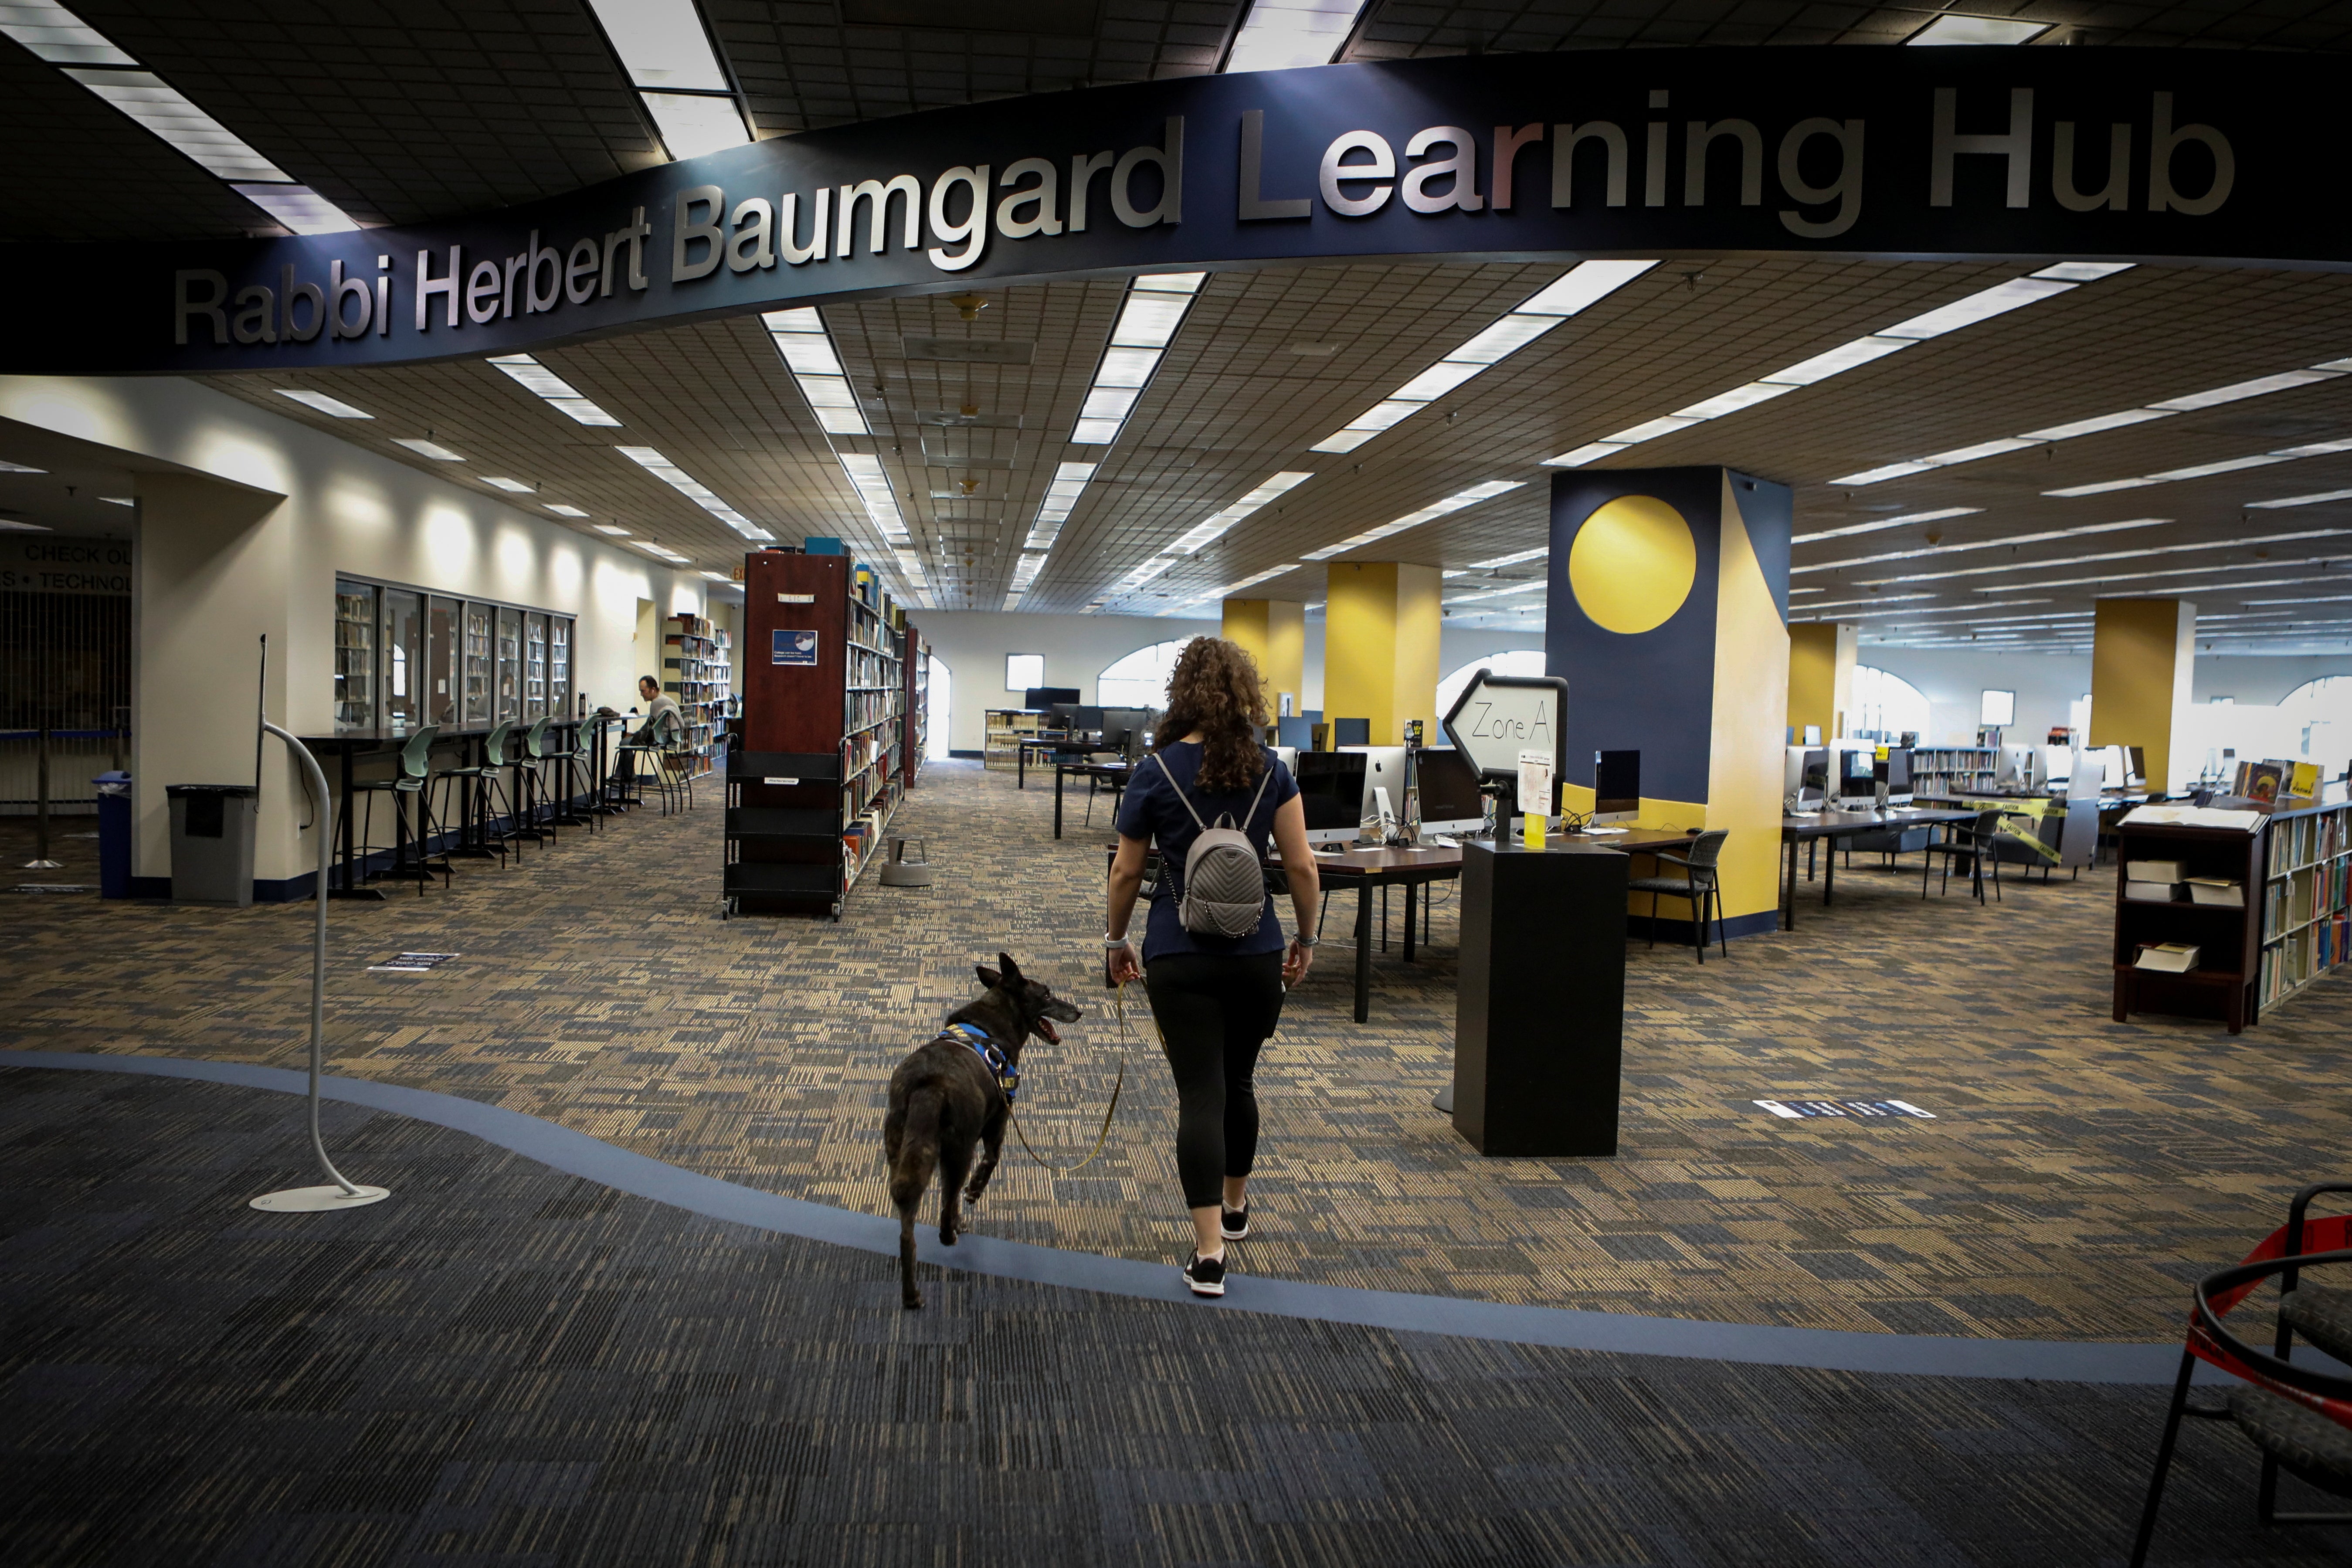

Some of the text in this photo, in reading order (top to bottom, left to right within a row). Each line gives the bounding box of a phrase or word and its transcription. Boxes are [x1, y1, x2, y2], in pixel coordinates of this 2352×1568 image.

[175, 87, 2235, 345] Rabbi Herbert Baumgard Learning Hub
[25, 545, 99, 563] CHECK
[1472, 700, 1551, 743] Zone A
[2006, 823, 2023, 836] CAUTION
[2039, 845, 2056, 858] CAUTION
